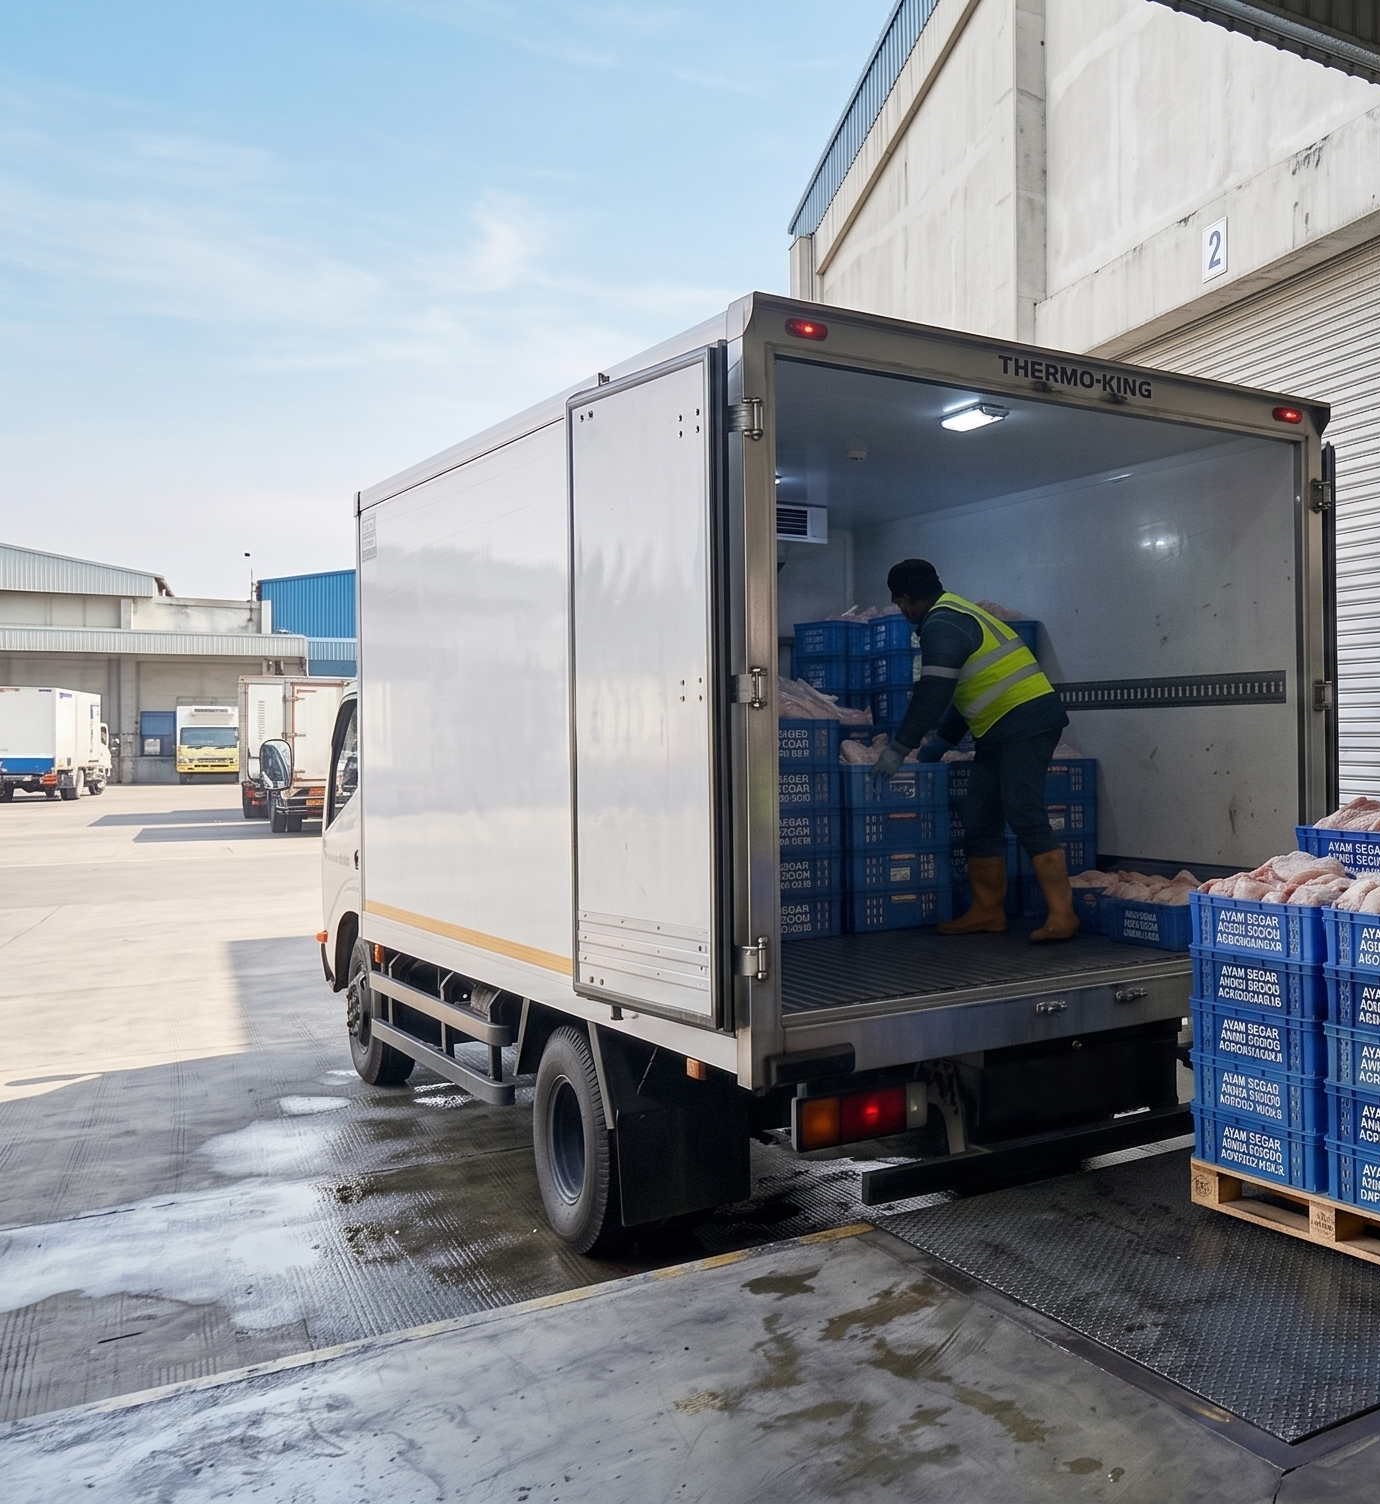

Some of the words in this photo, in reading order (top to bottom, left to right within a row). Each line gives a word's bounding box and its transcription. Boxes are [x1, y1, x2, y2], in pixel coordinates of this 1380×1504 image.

[1209, 230, 1221, 270] 2
[998, 354, 1152, 399] THERMO-KING
[1328, 841, 1353, 853] AYAM
[1220, 910, 1244, 923] AYAM
[1247, 914, 1279, 927] SEGAR
[1221, 965, 1245, 978] AYAM
[1247, 969, 1278, 983] SEGAR
[1223, 1019, 1246, 1033] AYAM
[1248, 1023, 1279, 1040] SEGAR
[1223, 1072, 1246, 1087] AYAM
[1224, 1126, 1246, 1142] AYAM
[1250, 1132, 1281, 1151] SEGAR
